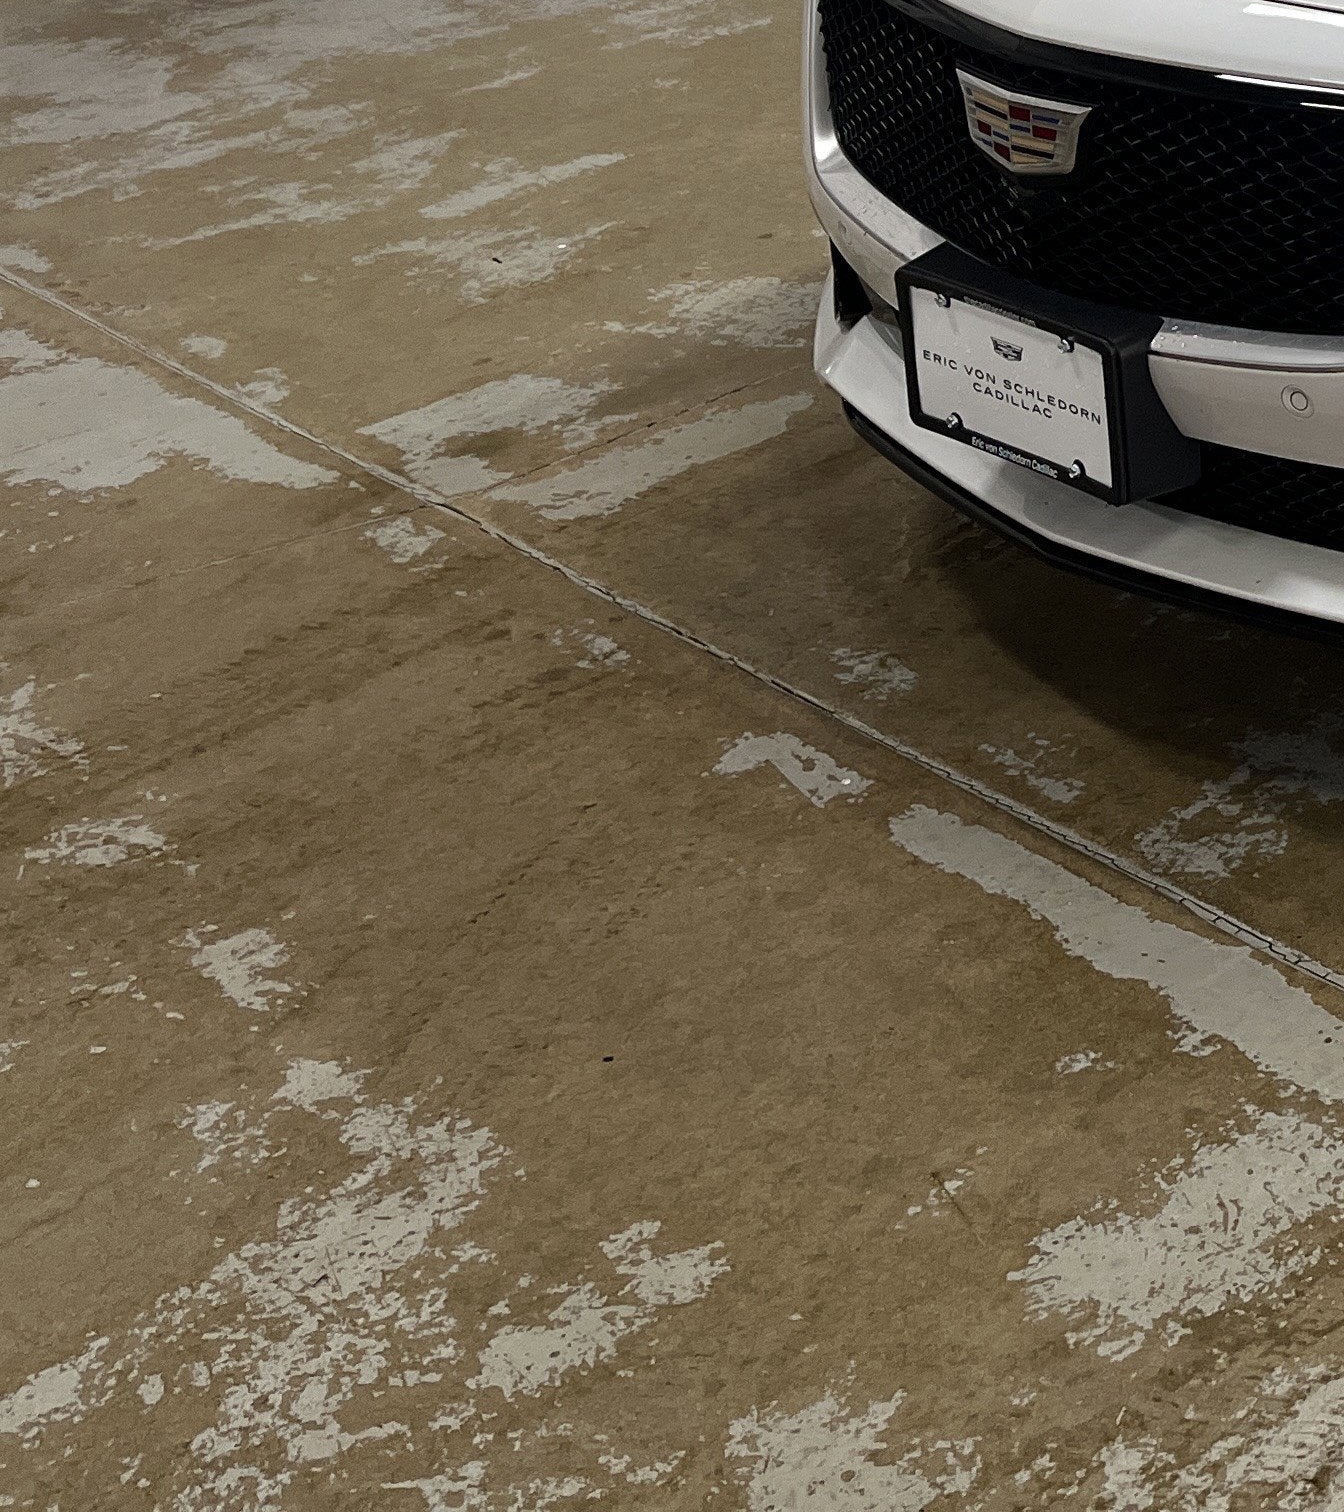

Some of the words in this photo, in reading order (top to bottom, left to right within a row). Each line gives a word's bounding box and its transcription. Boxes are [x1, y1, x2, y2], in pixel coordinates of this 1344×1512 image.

[923, 349, 958, 370] ERIC
[964, 364, 996, 384] VON
[1003, 379, 1101, 425] SCHLEDORN
[972, 382, 1053, 419] CADILLAC
[971, 436, 985, 448] Eric
